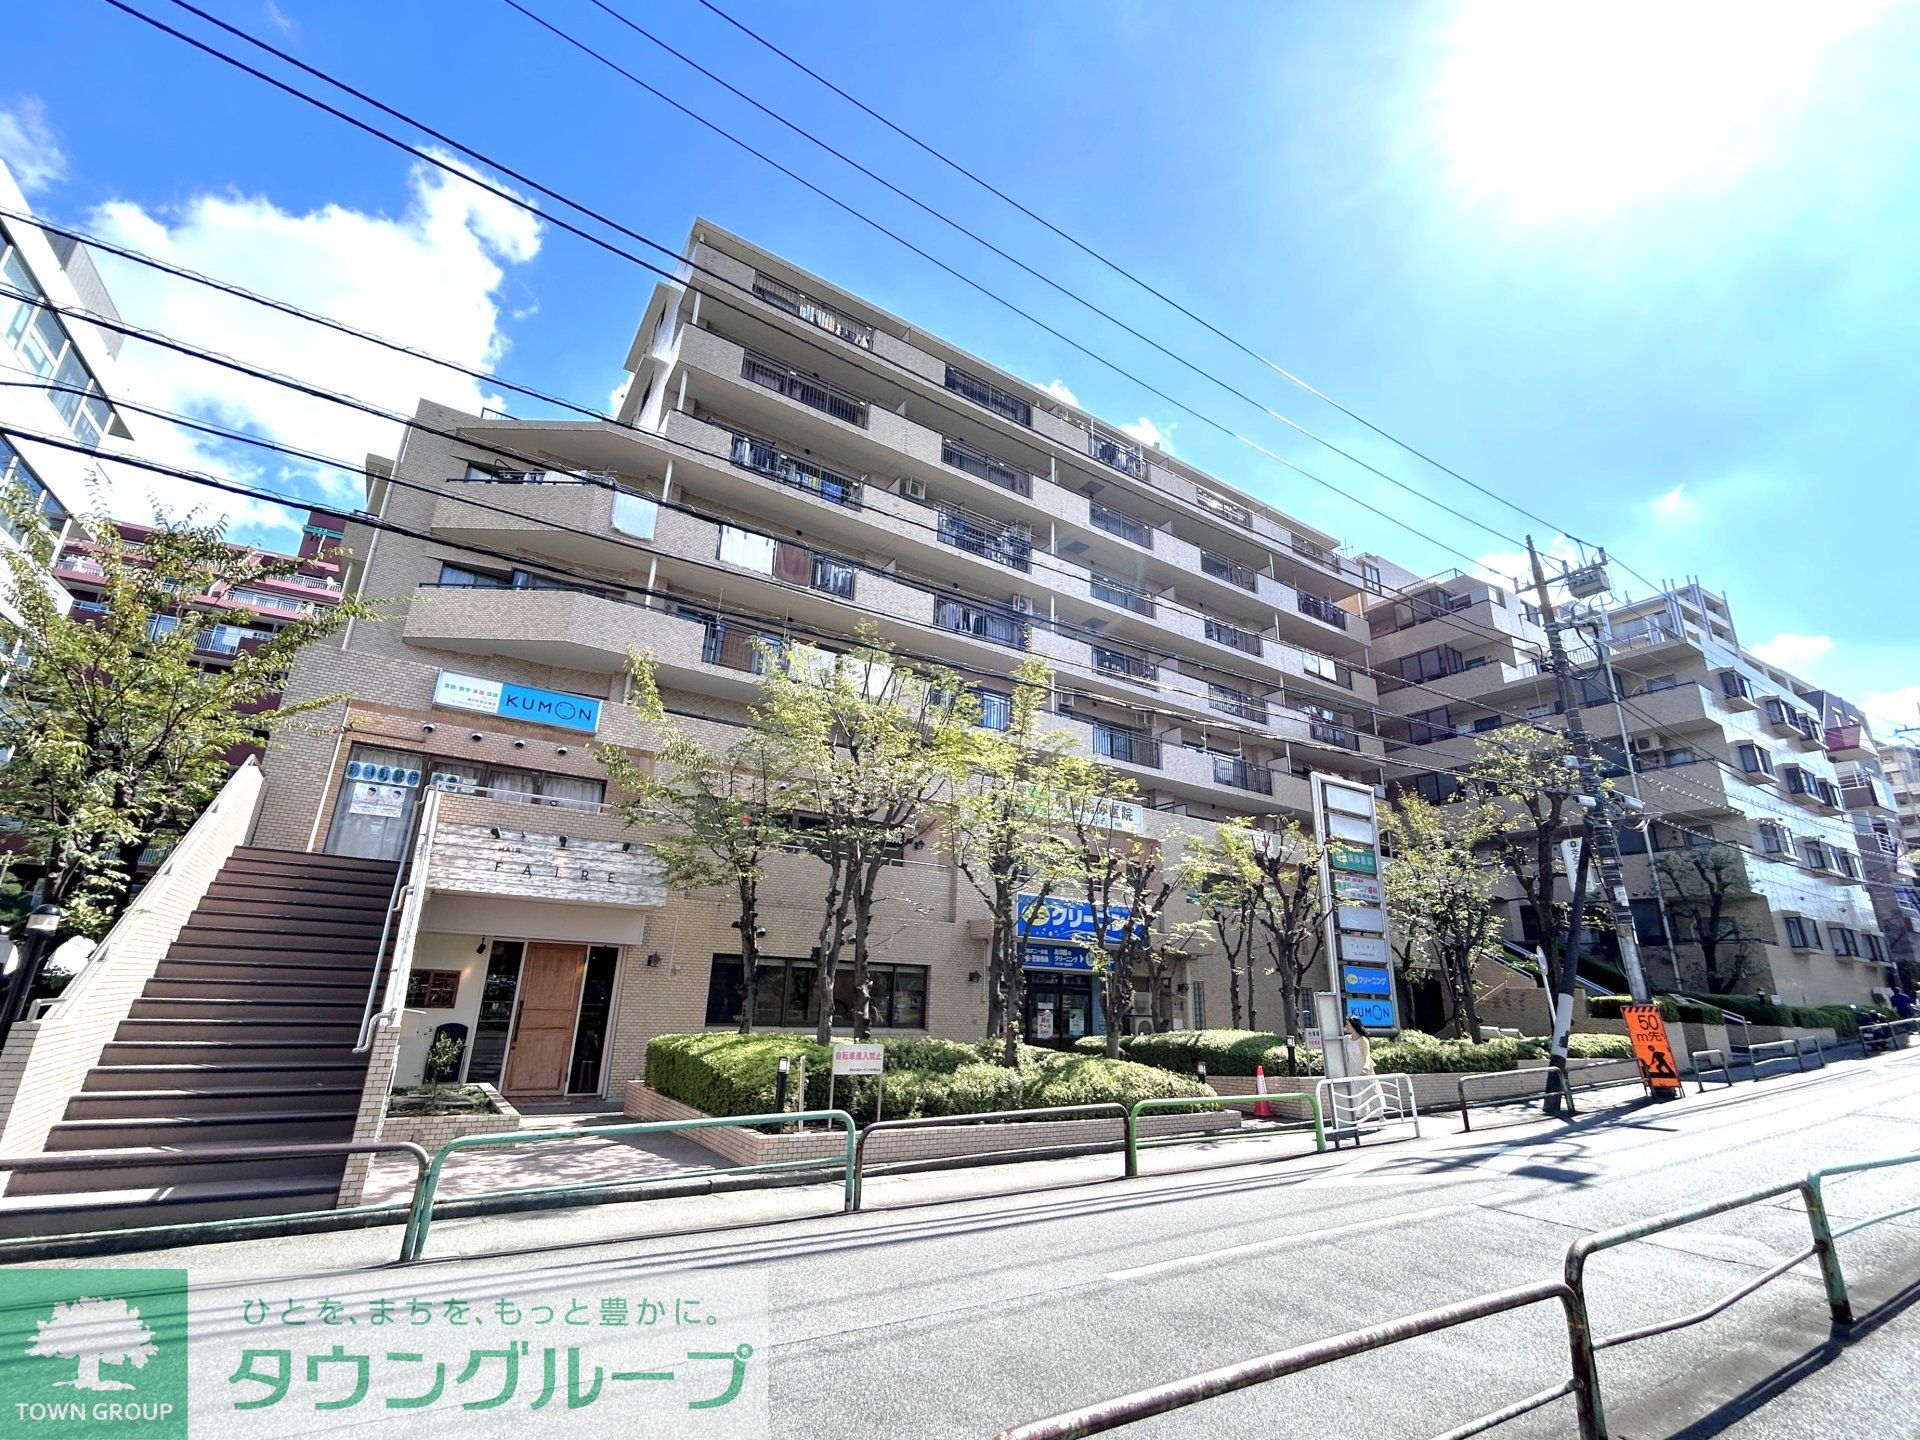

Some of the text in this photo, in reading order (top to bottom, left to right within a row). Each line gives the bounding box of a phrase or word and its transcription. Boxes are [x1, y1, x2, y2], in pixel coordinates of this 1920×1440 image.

[506, 694, 593, 721] KUMON
[494, 861, 616, 883] FAIRE
[1351, 1005, 1390, 1020] KUMON
[1637, 1014, 1659, 1030] 50
